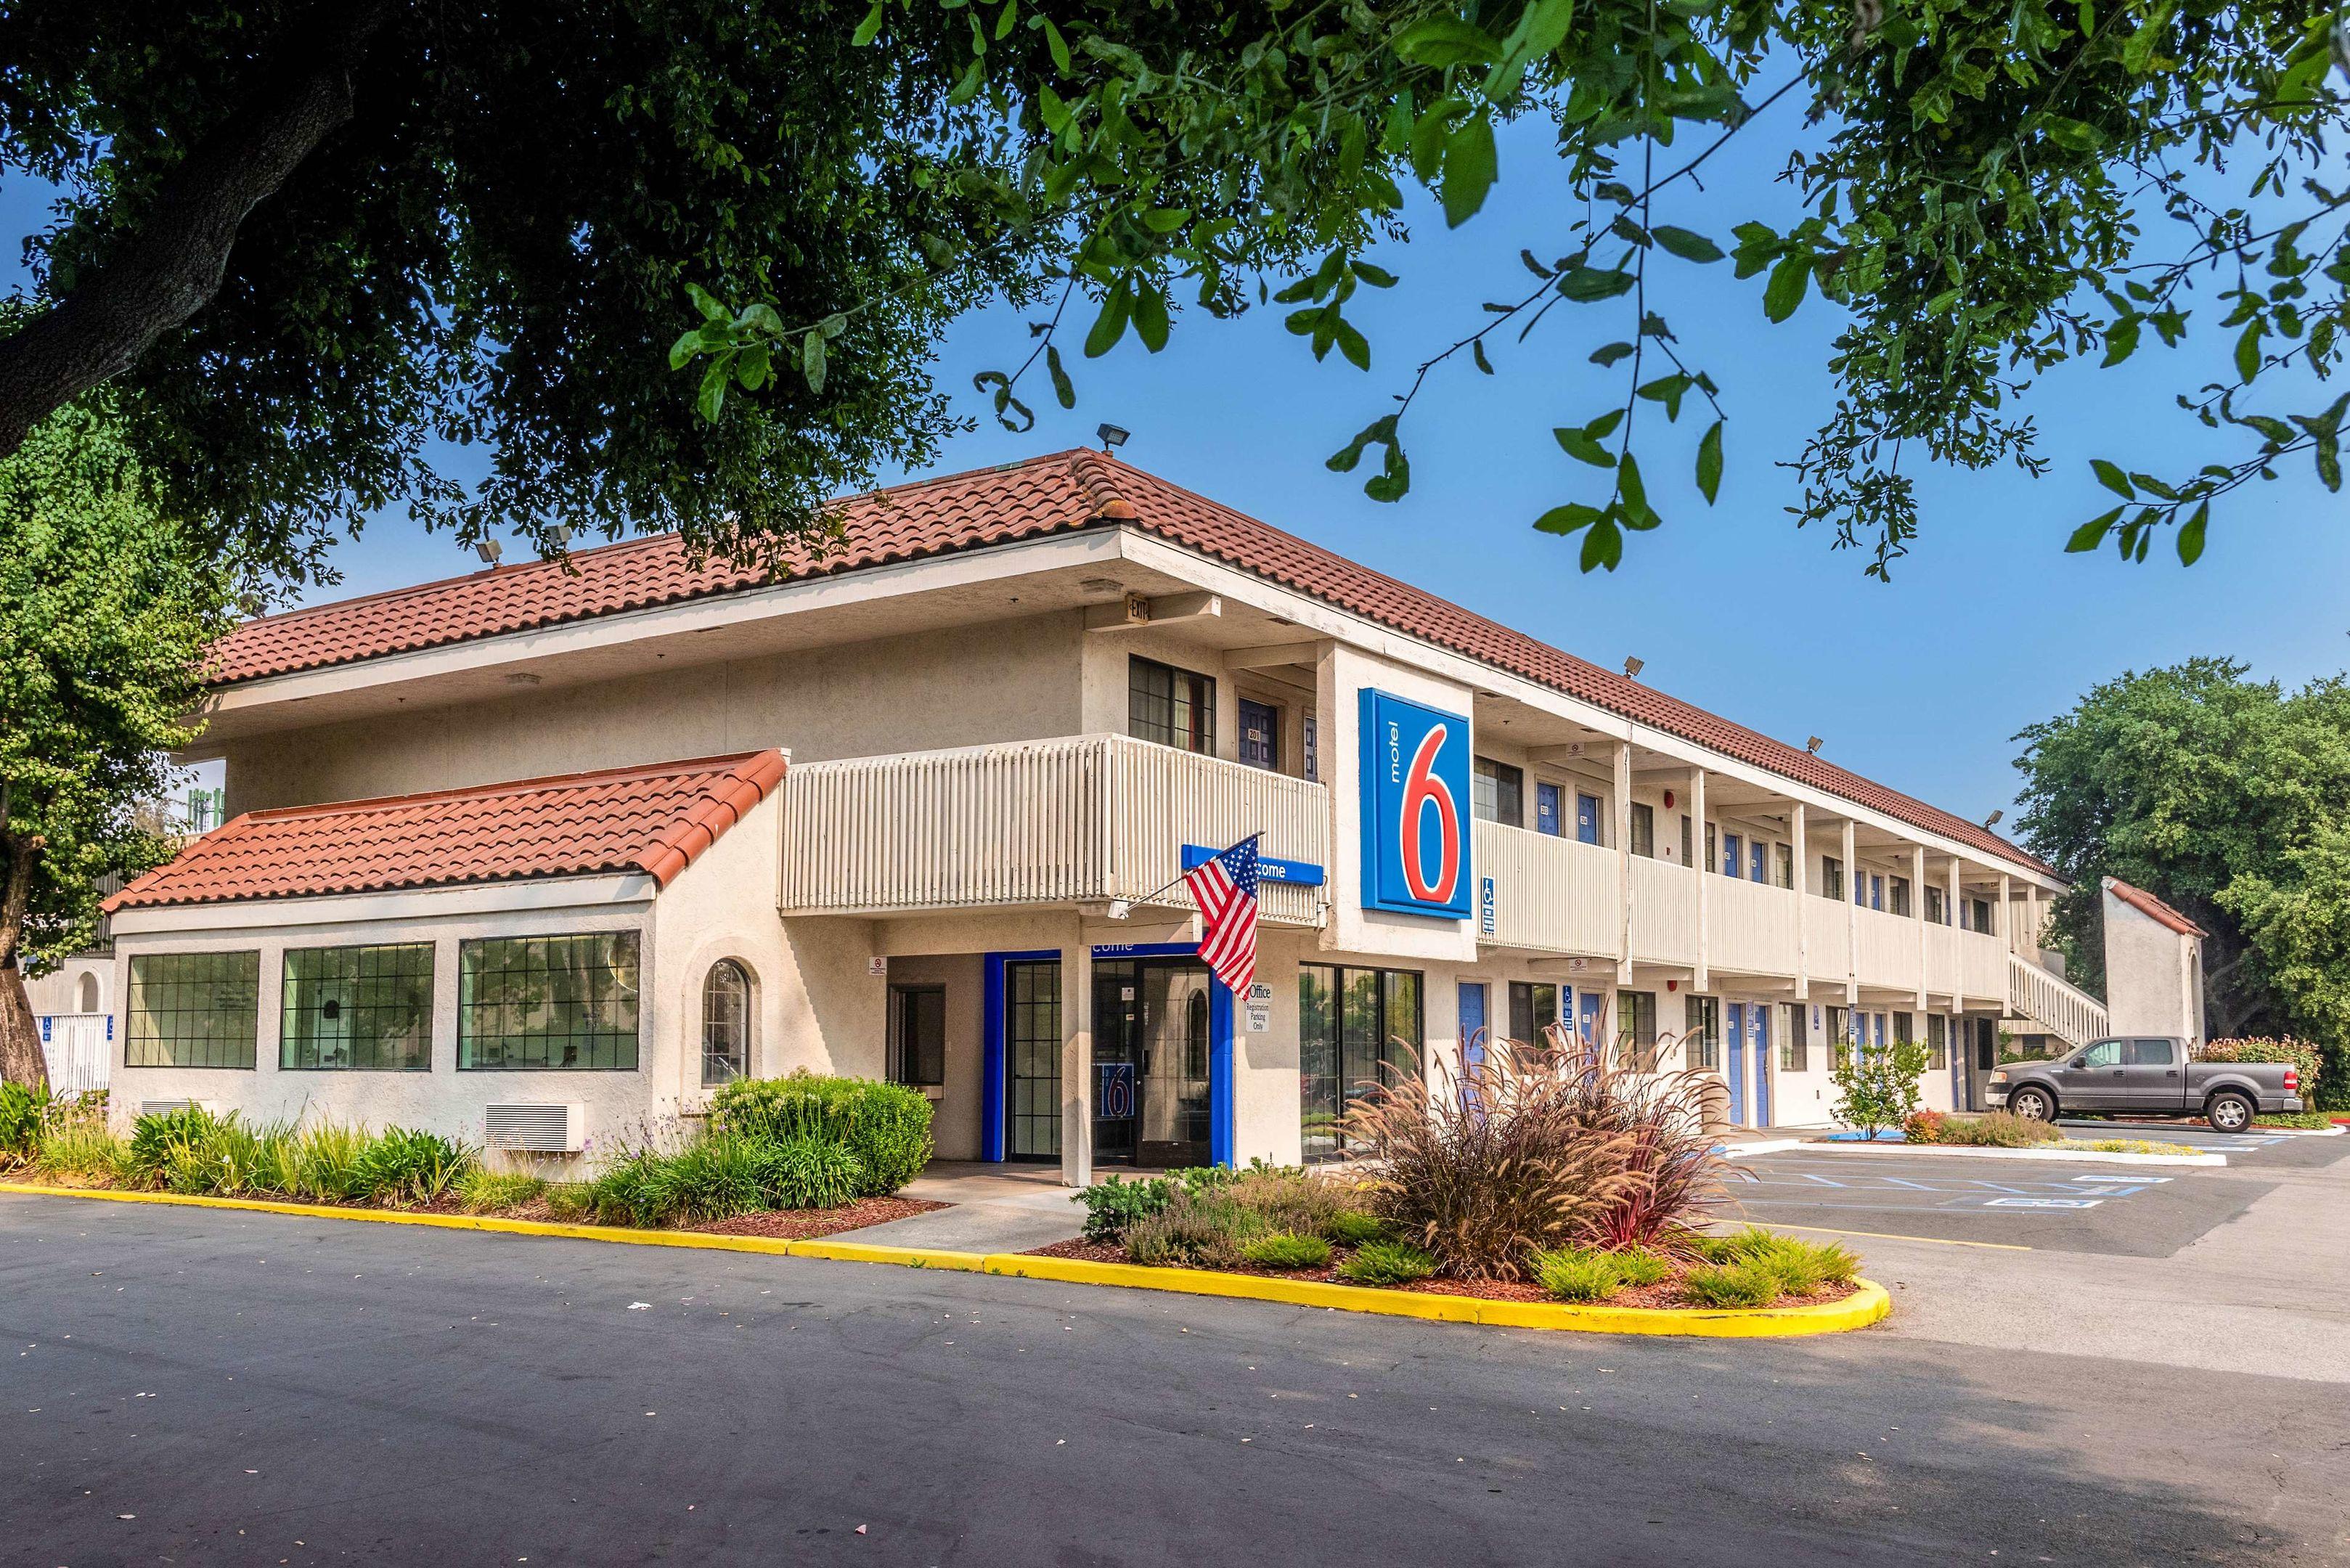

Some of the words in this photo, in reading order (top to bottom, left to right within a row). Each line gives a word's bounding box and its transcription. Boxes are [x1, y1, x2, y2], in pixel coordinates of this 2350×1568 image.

[1132, 599, 1146, 619] EXIT
[1249, 730, 1260, 740] 201
[1389, 721, 1400, 783] motel
[1400, 723, 1460, 905] 6
[1249, 984, 1271, 998] Office
[1247, 1003, 1269, 1012] Registration
[1250, 1013, 1266, 1022] Parking
[1253, 1022, 1263, 1031] Only
[1108, 1066, 1130, 1116] 6
